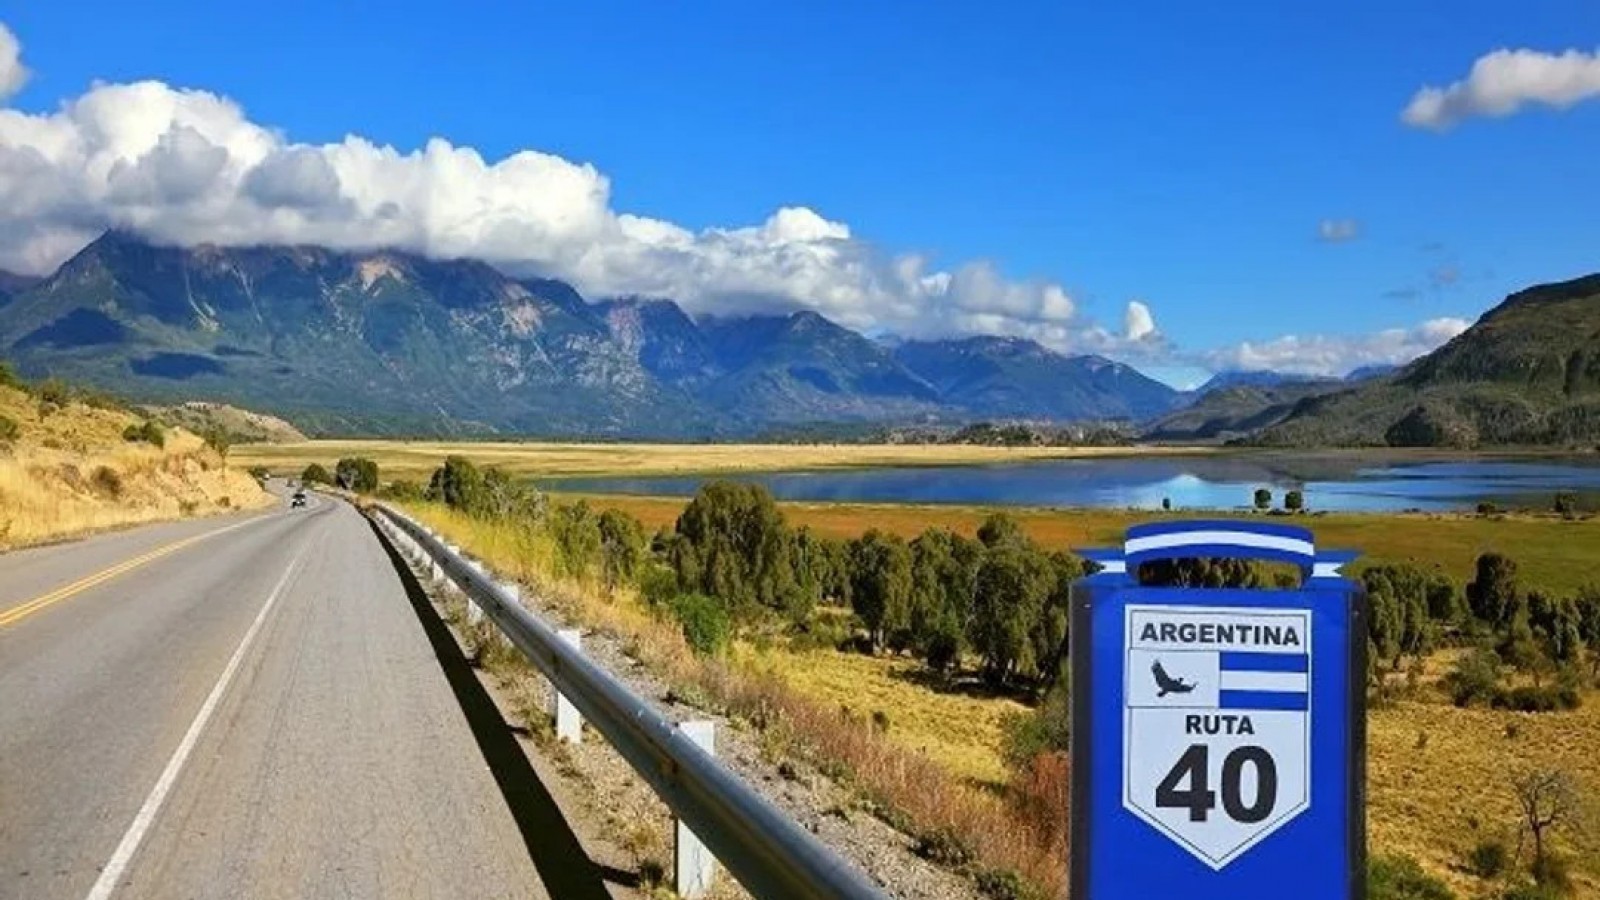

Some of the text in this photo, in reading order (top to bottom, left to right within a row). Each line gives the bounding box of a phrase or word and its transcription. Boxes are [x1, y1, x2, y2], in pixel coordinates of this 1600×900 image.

[1140, 622, 1300, 646] ARGENTINA
[1185, 714, 1255, 735] RUTA
[1155, 743, 1278, 824] 40
